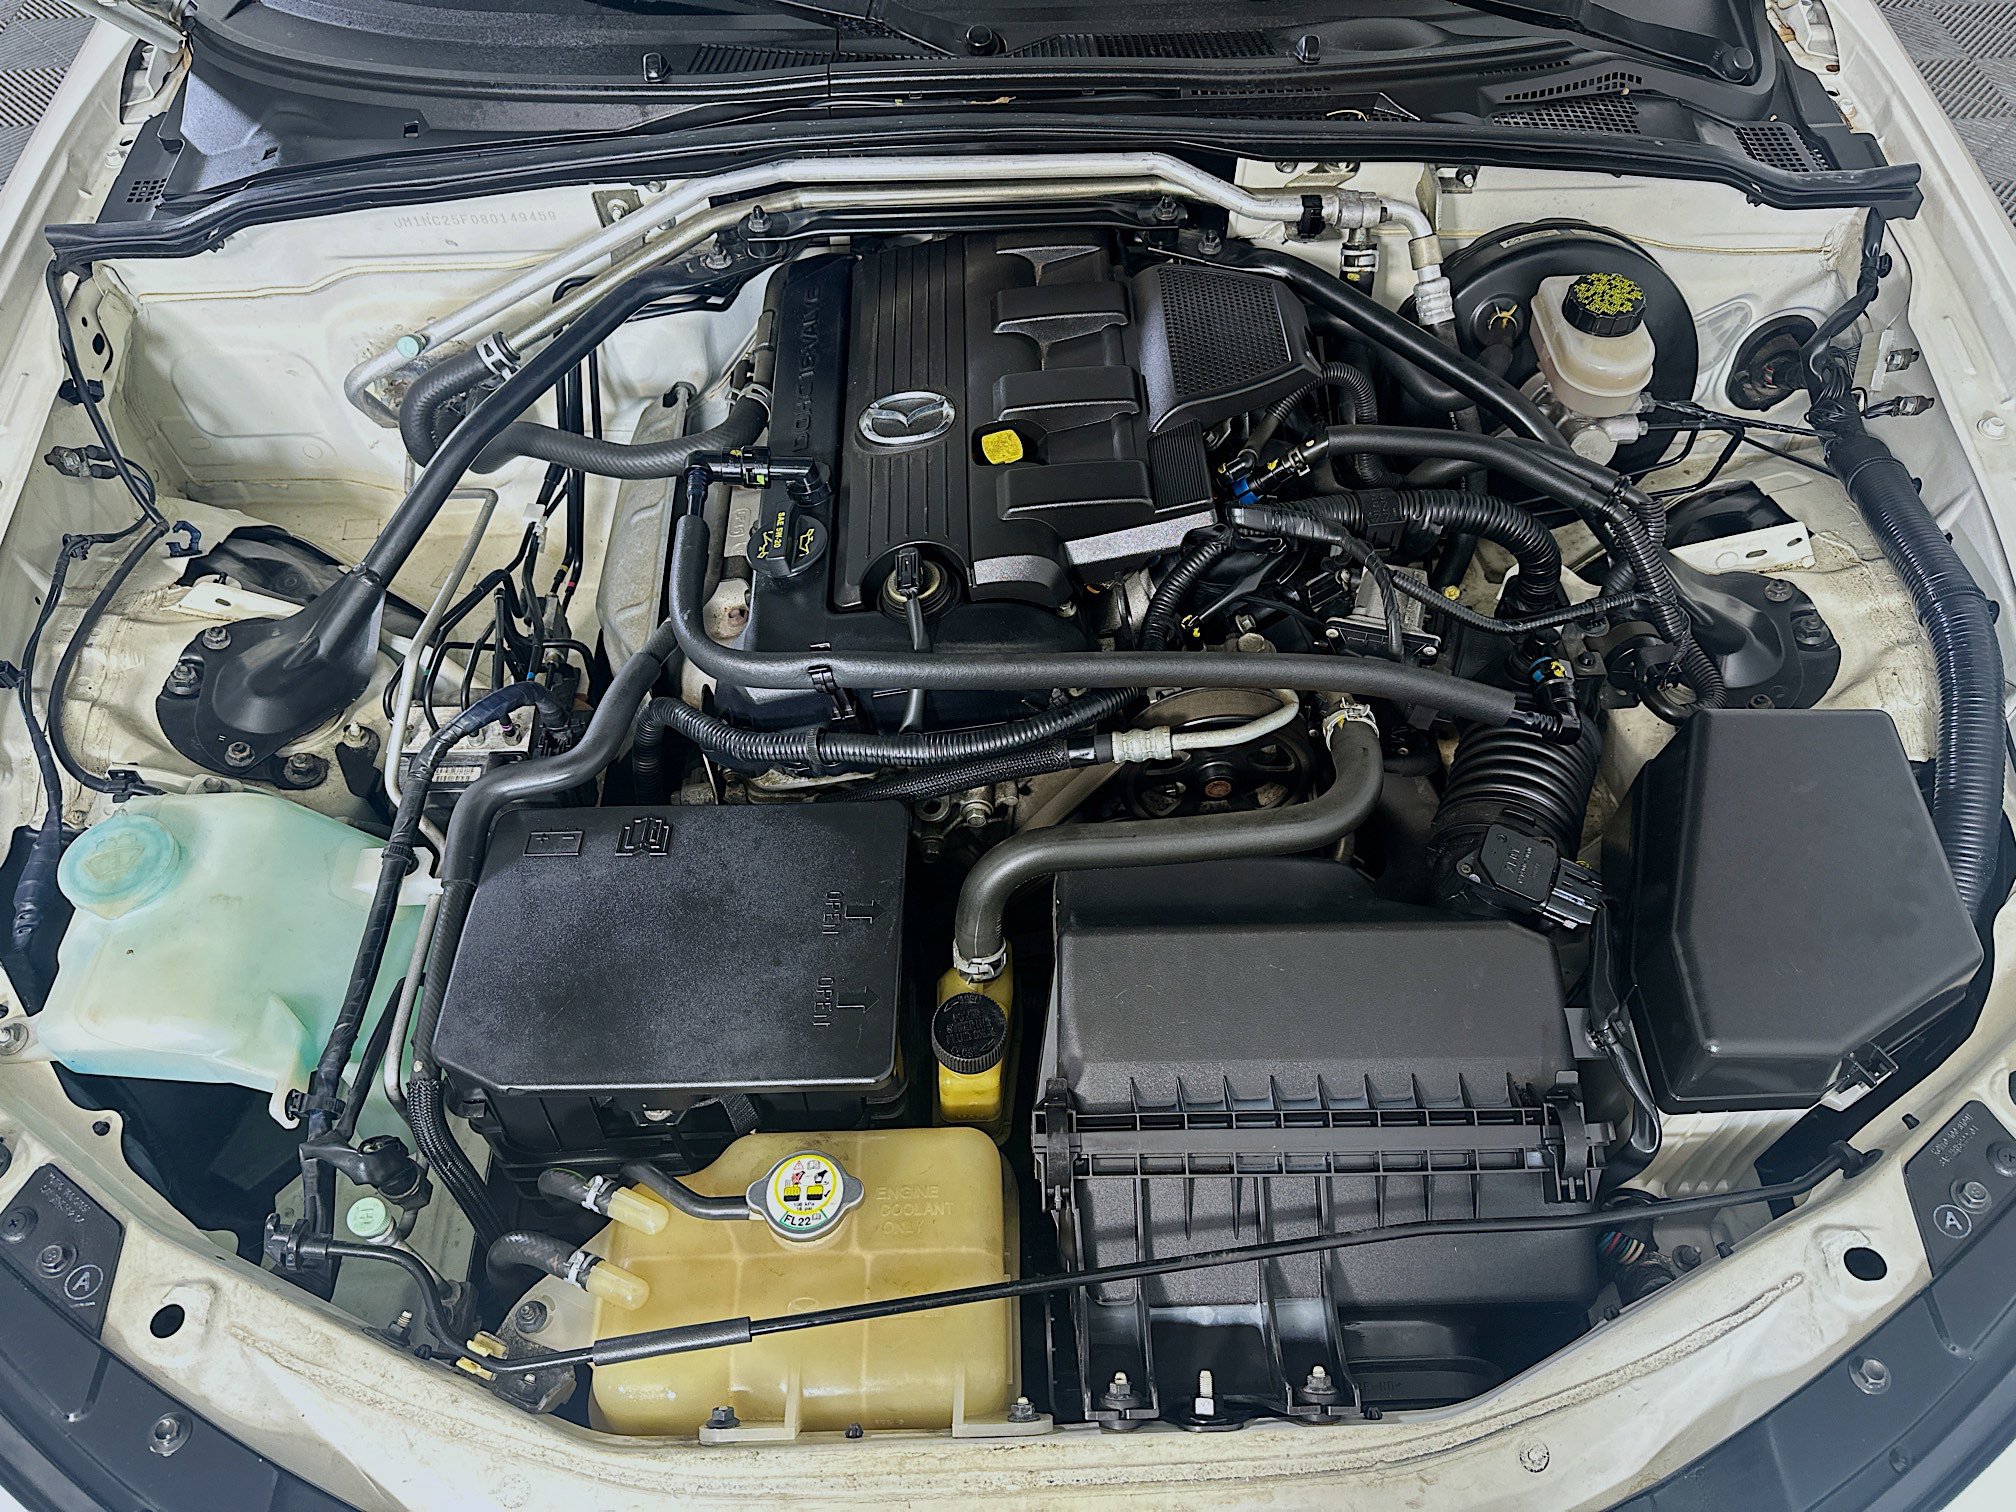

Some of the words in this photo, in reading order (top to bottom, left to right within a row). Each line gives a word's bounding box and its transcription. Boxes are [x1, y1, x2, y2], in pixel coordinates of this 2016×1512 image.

[776, 511, 785, 526] SAE
[773, 527, 783, 548] 5W-20
[822, 890, 844, 935] OPEN
[812, 977, 834, 1027] OPEN
[876, 1185, 939, 1200] ENGINE
[879, 1200, 954, 1217] COOLANT
[784, 1214, 812, 1227] FL22
[1945, 1211, 1963, 1231] A
[72, 1271, 91, 1292] A
